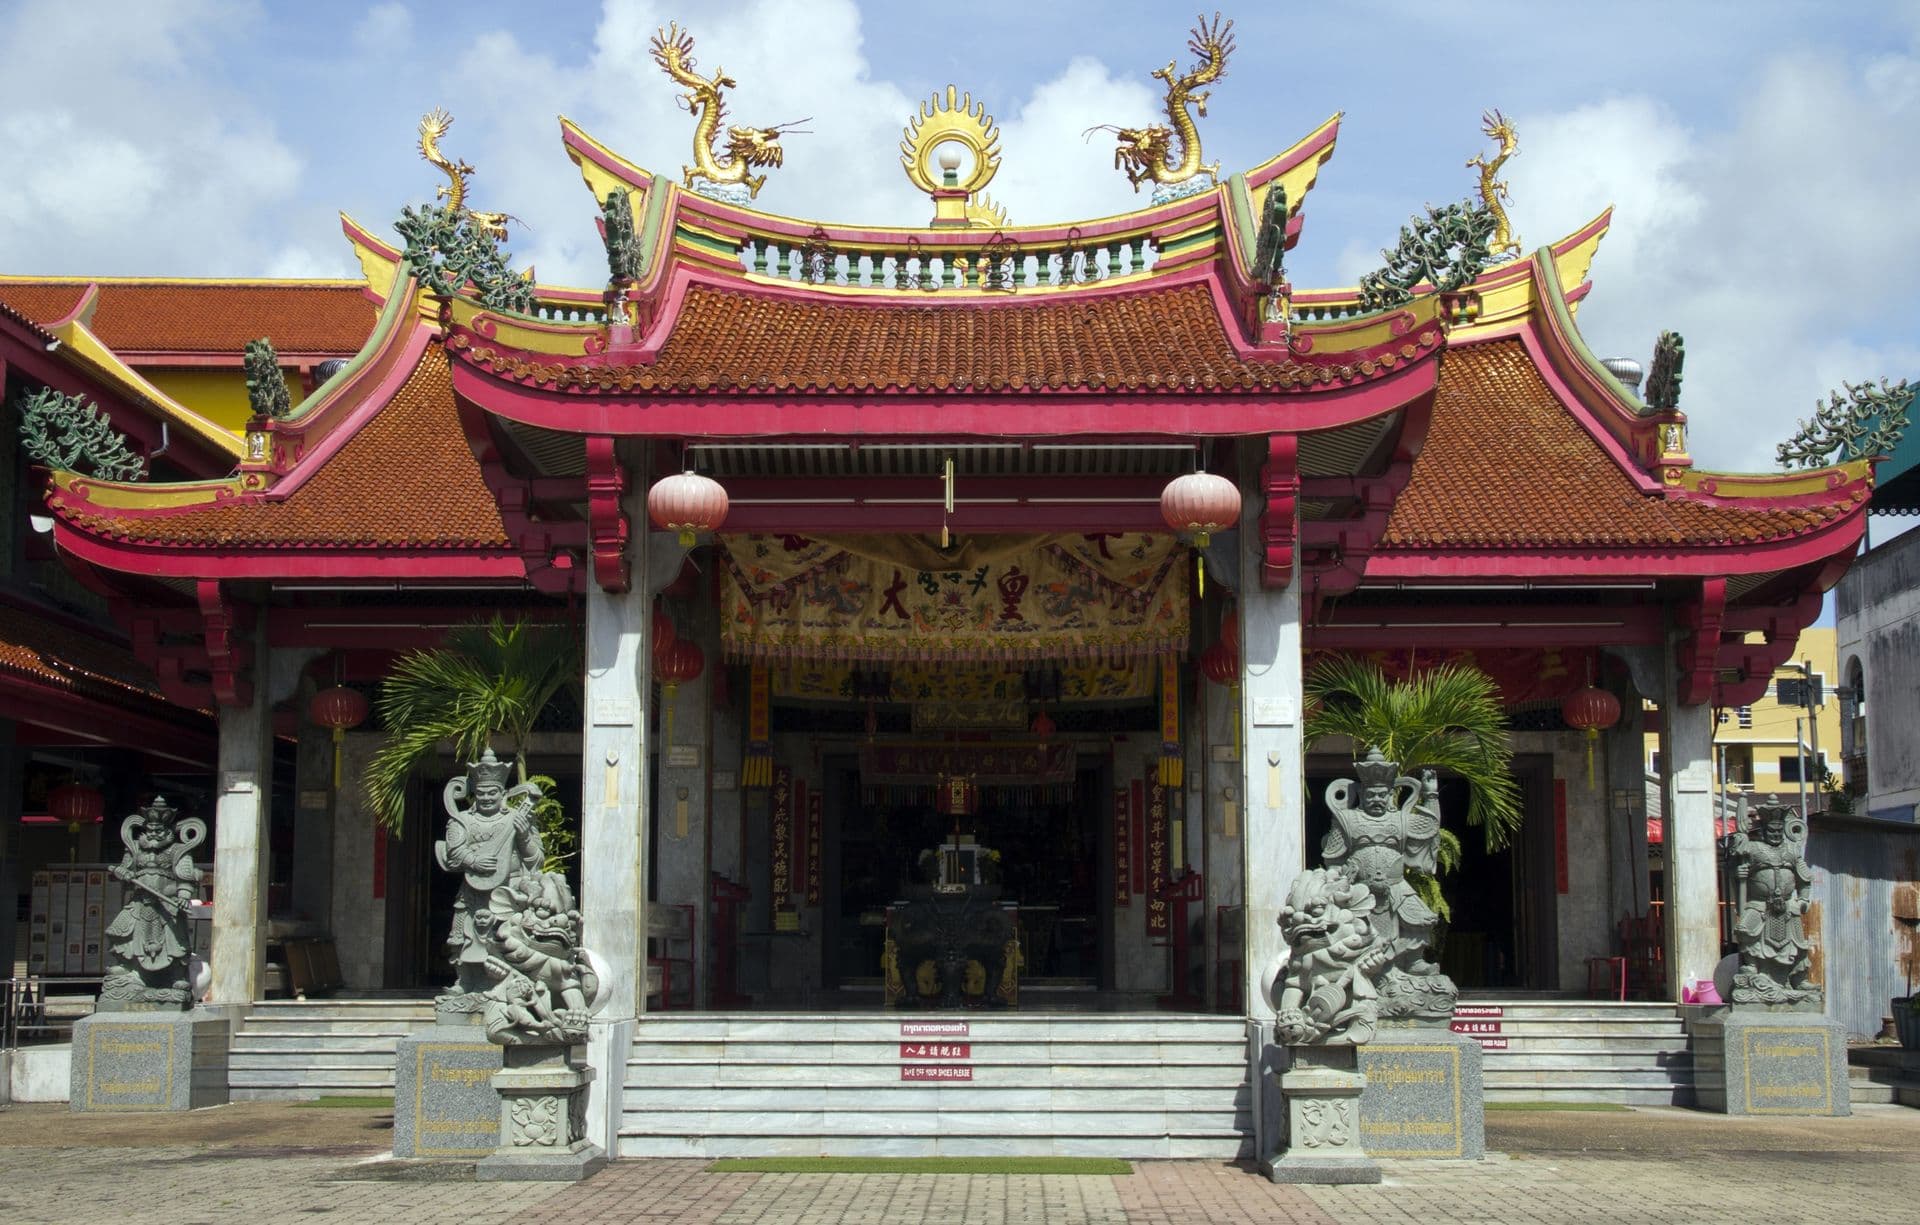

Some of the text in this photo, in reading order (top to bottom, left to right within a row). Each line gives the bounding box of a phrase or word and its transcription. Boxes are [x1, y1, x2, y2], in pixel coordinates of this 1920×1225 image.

[878, 569, 911, 620] 大
[904, 1068, 915, 1077] TAKE
[926, 1068, 938, 1077] YOUR
[938, 1068, 953, 1078] SHOES
[953, 1068, 971, 1078] PLEASE
